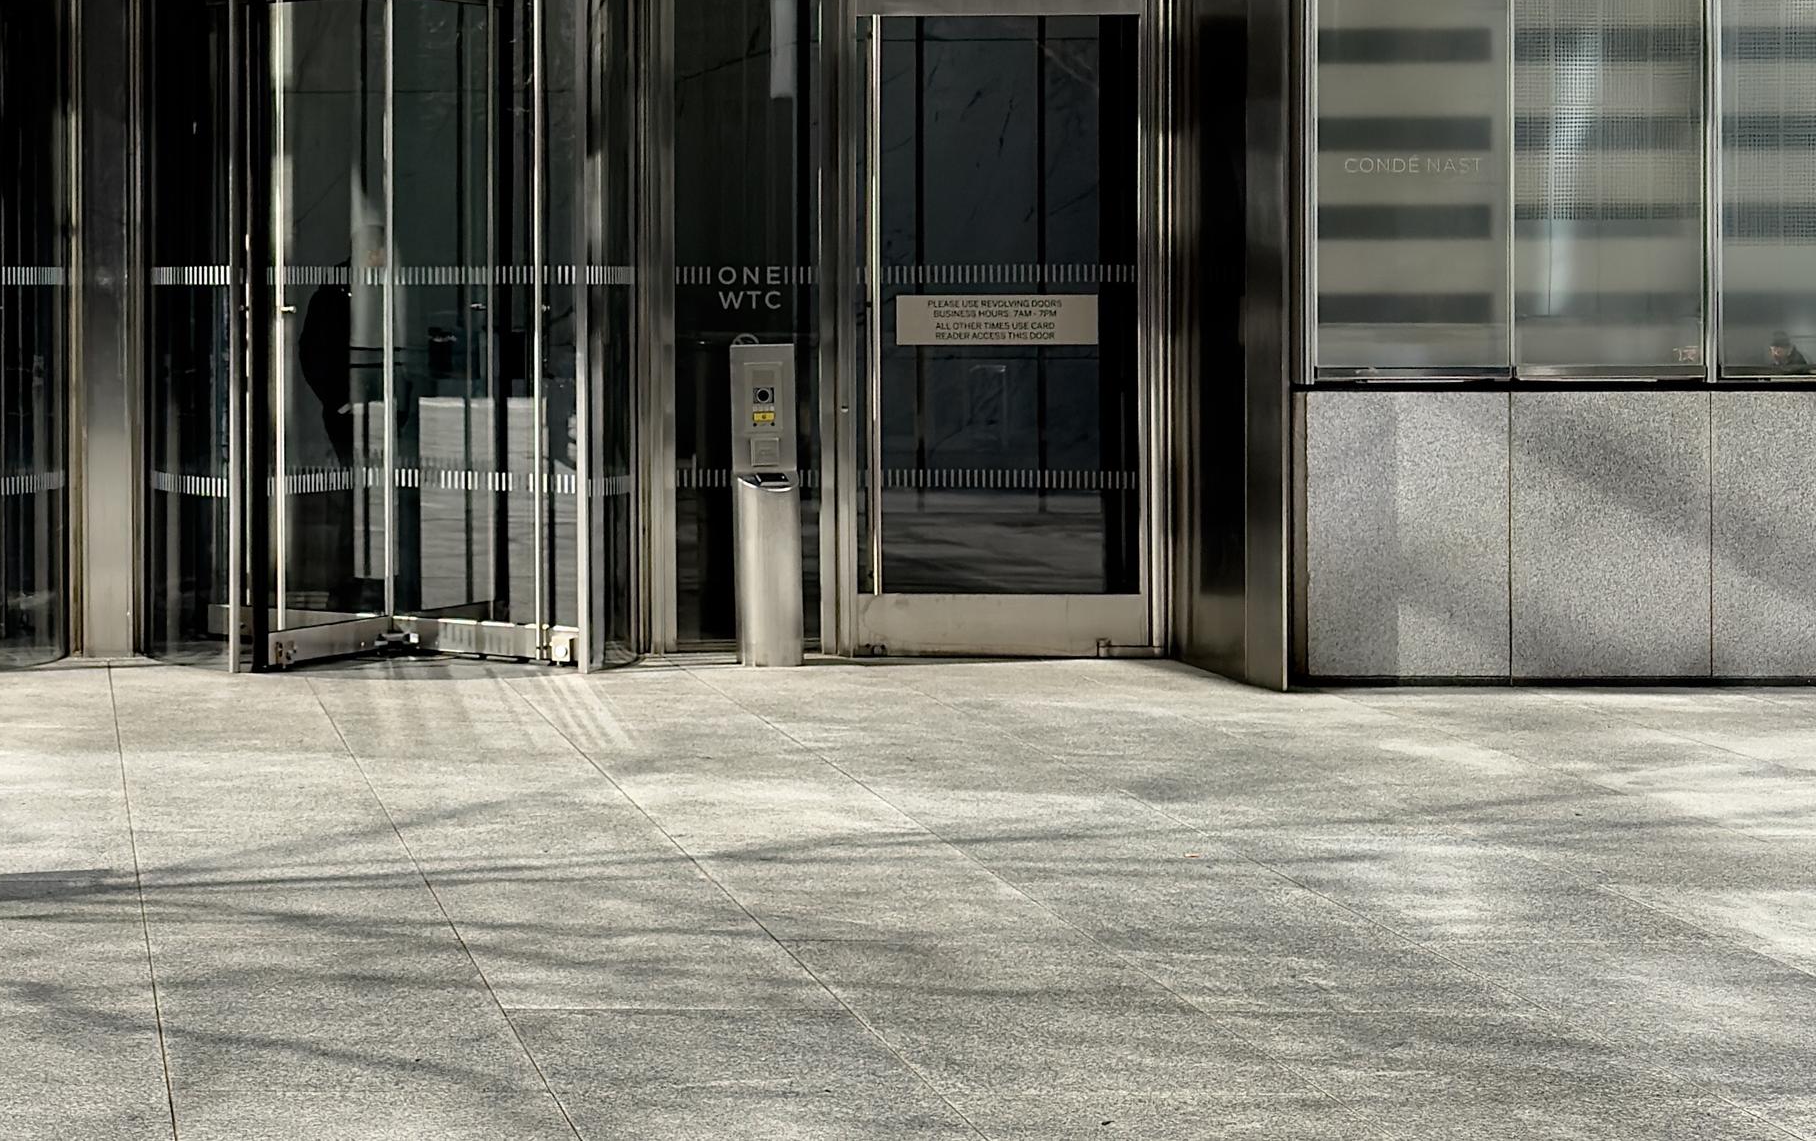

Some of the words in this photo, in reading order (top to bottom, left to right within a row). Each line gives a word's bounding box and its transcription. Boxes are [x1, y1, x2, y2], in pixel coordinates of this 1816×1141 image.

[1344, 154, 1420, 173] CONDÉ
[1427, 157, 1483, 173] NAST
[718, 266, 781, 285] ONE
[718, 291, 781, 310] WTC
[927, 299, 960, 308] PLEASE
[961, 299, 979, 308] USE
[980, 299, 1030, 308] REVOLVING
[1031, 299, 1063, 308] DOORS
[933, 310, 976, 318] BUSINESS
[935, 322, 951, 330] ALL
[952, 322, 981, 330] OTHER
[984, 322, 1010, 330] TIMES
[1012, 322, 1028, 330] USE
[1031, 322, 1055, 330] CARD
[935, 332, 970, 340] READER
[971, 332, 1006, 340] ACCESS
[1008, 332, 1028, 340] THIS
[1030, 332, 1055, 340] DOOR
